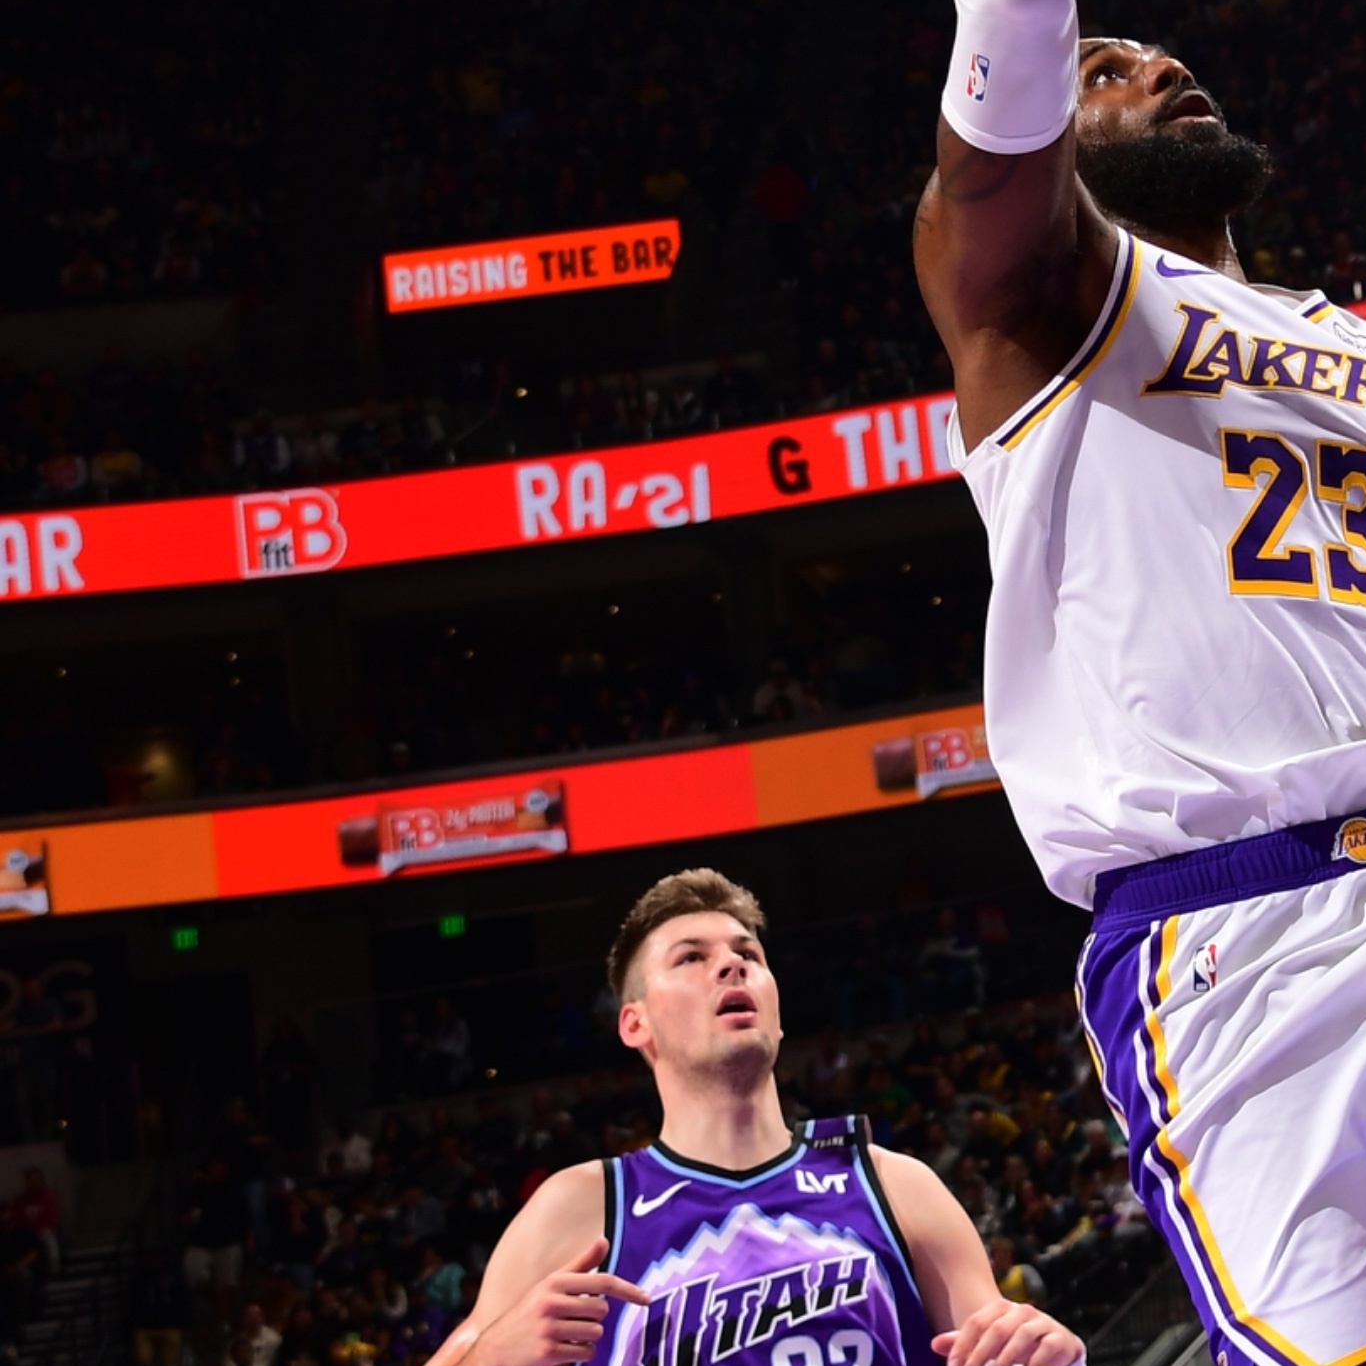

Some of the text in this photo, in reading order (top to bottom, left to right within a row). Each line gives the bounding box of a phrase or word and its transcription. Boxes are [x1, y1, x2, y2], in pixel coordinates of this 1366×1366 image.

[391, 236, 674, 304] RAISING THE BAR
[768, 434, 812, 496] G
[235, 488, 347, 579] PB
[795, 1169, 849, 1194] LVT
